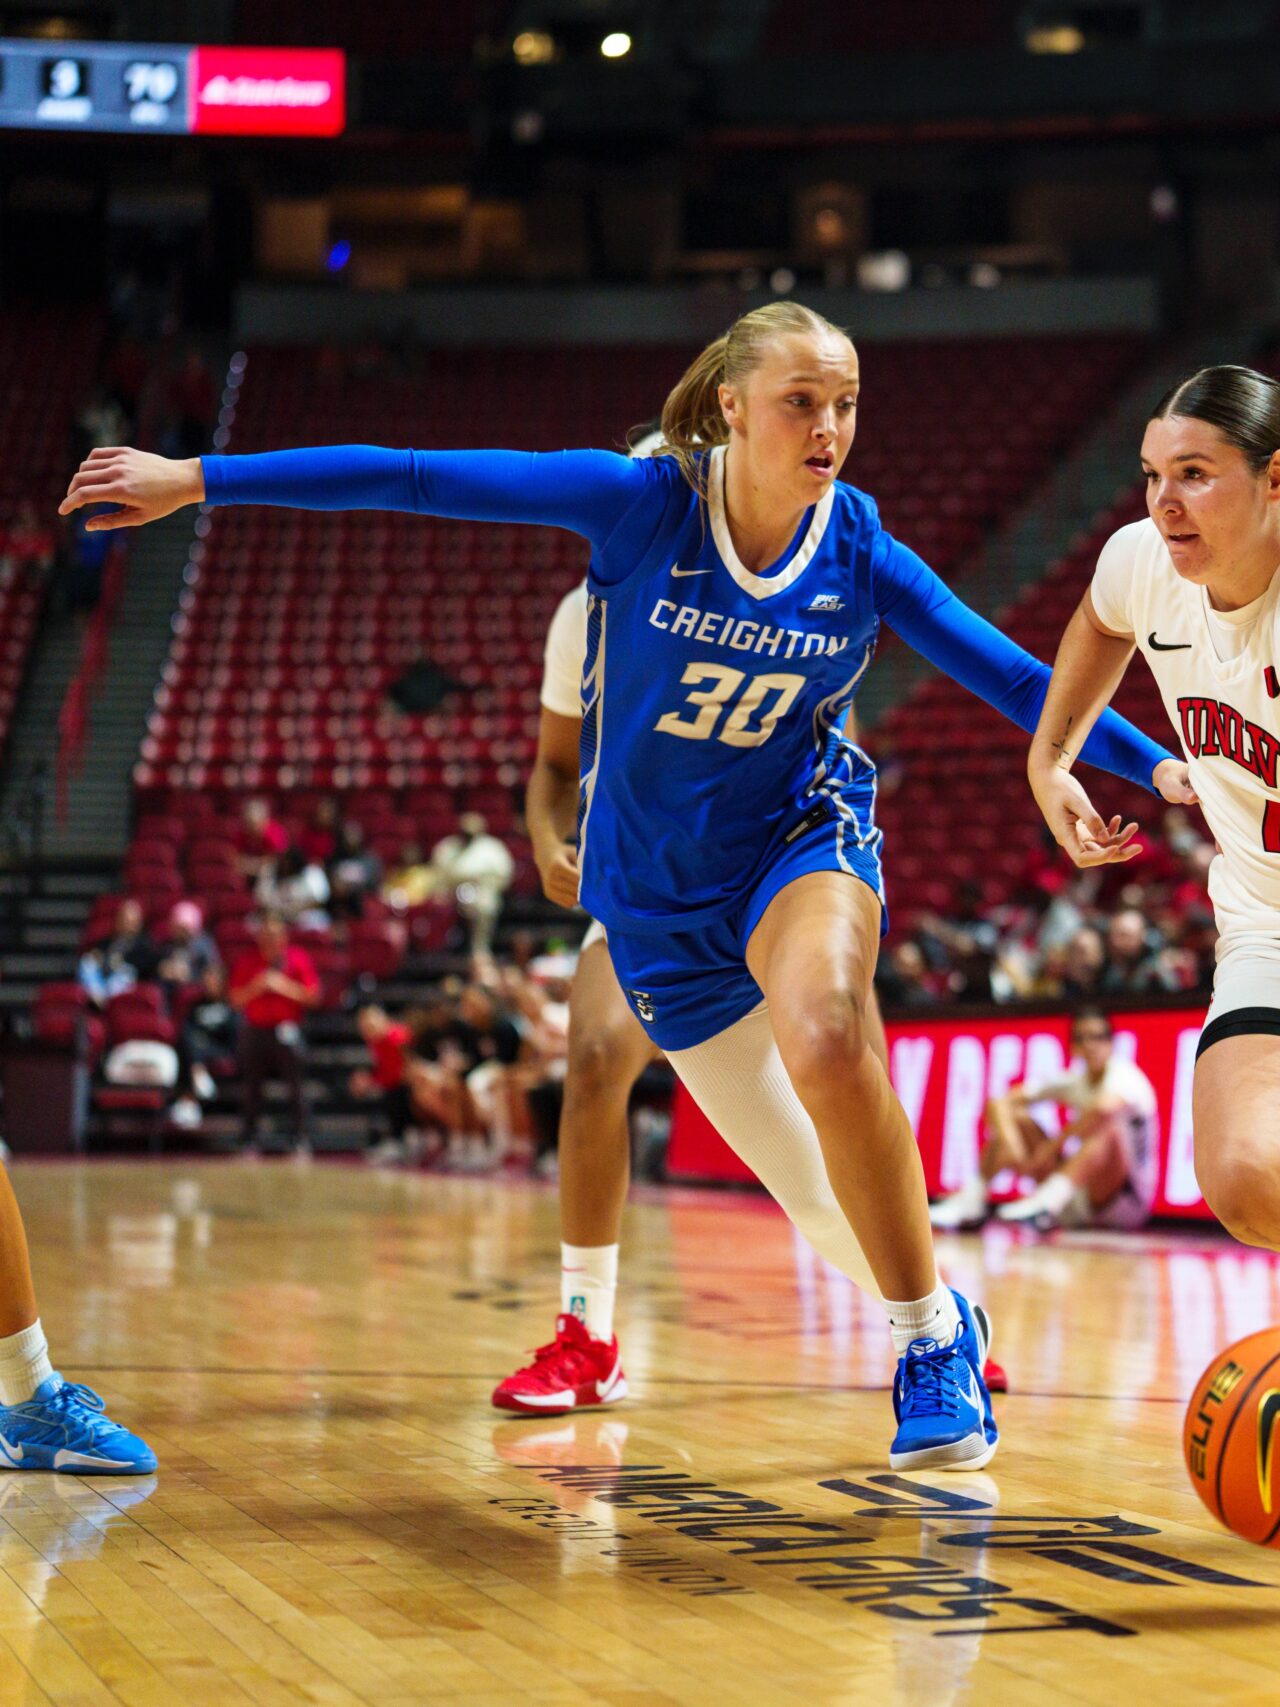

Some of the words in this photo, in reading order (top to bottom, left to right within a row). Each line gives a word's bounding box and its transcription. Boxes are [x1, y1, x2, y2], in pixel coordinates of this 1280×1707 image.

[649, 599, 849, 659] CREIGHTON
[810, 601, 846, 610] EAST
[815, 594, 840, 602] BIG
[653, 661, 807, 748] 30
[1189, 1360, 1244, 1482] ELITE
[488, 1498, 633, 1541] CREDIT
[600, 1547, 756, 1597] UNION
[515, 1465, 877, 1555] AMERICA
[752, 1555, 1140, 1637] FIRST
